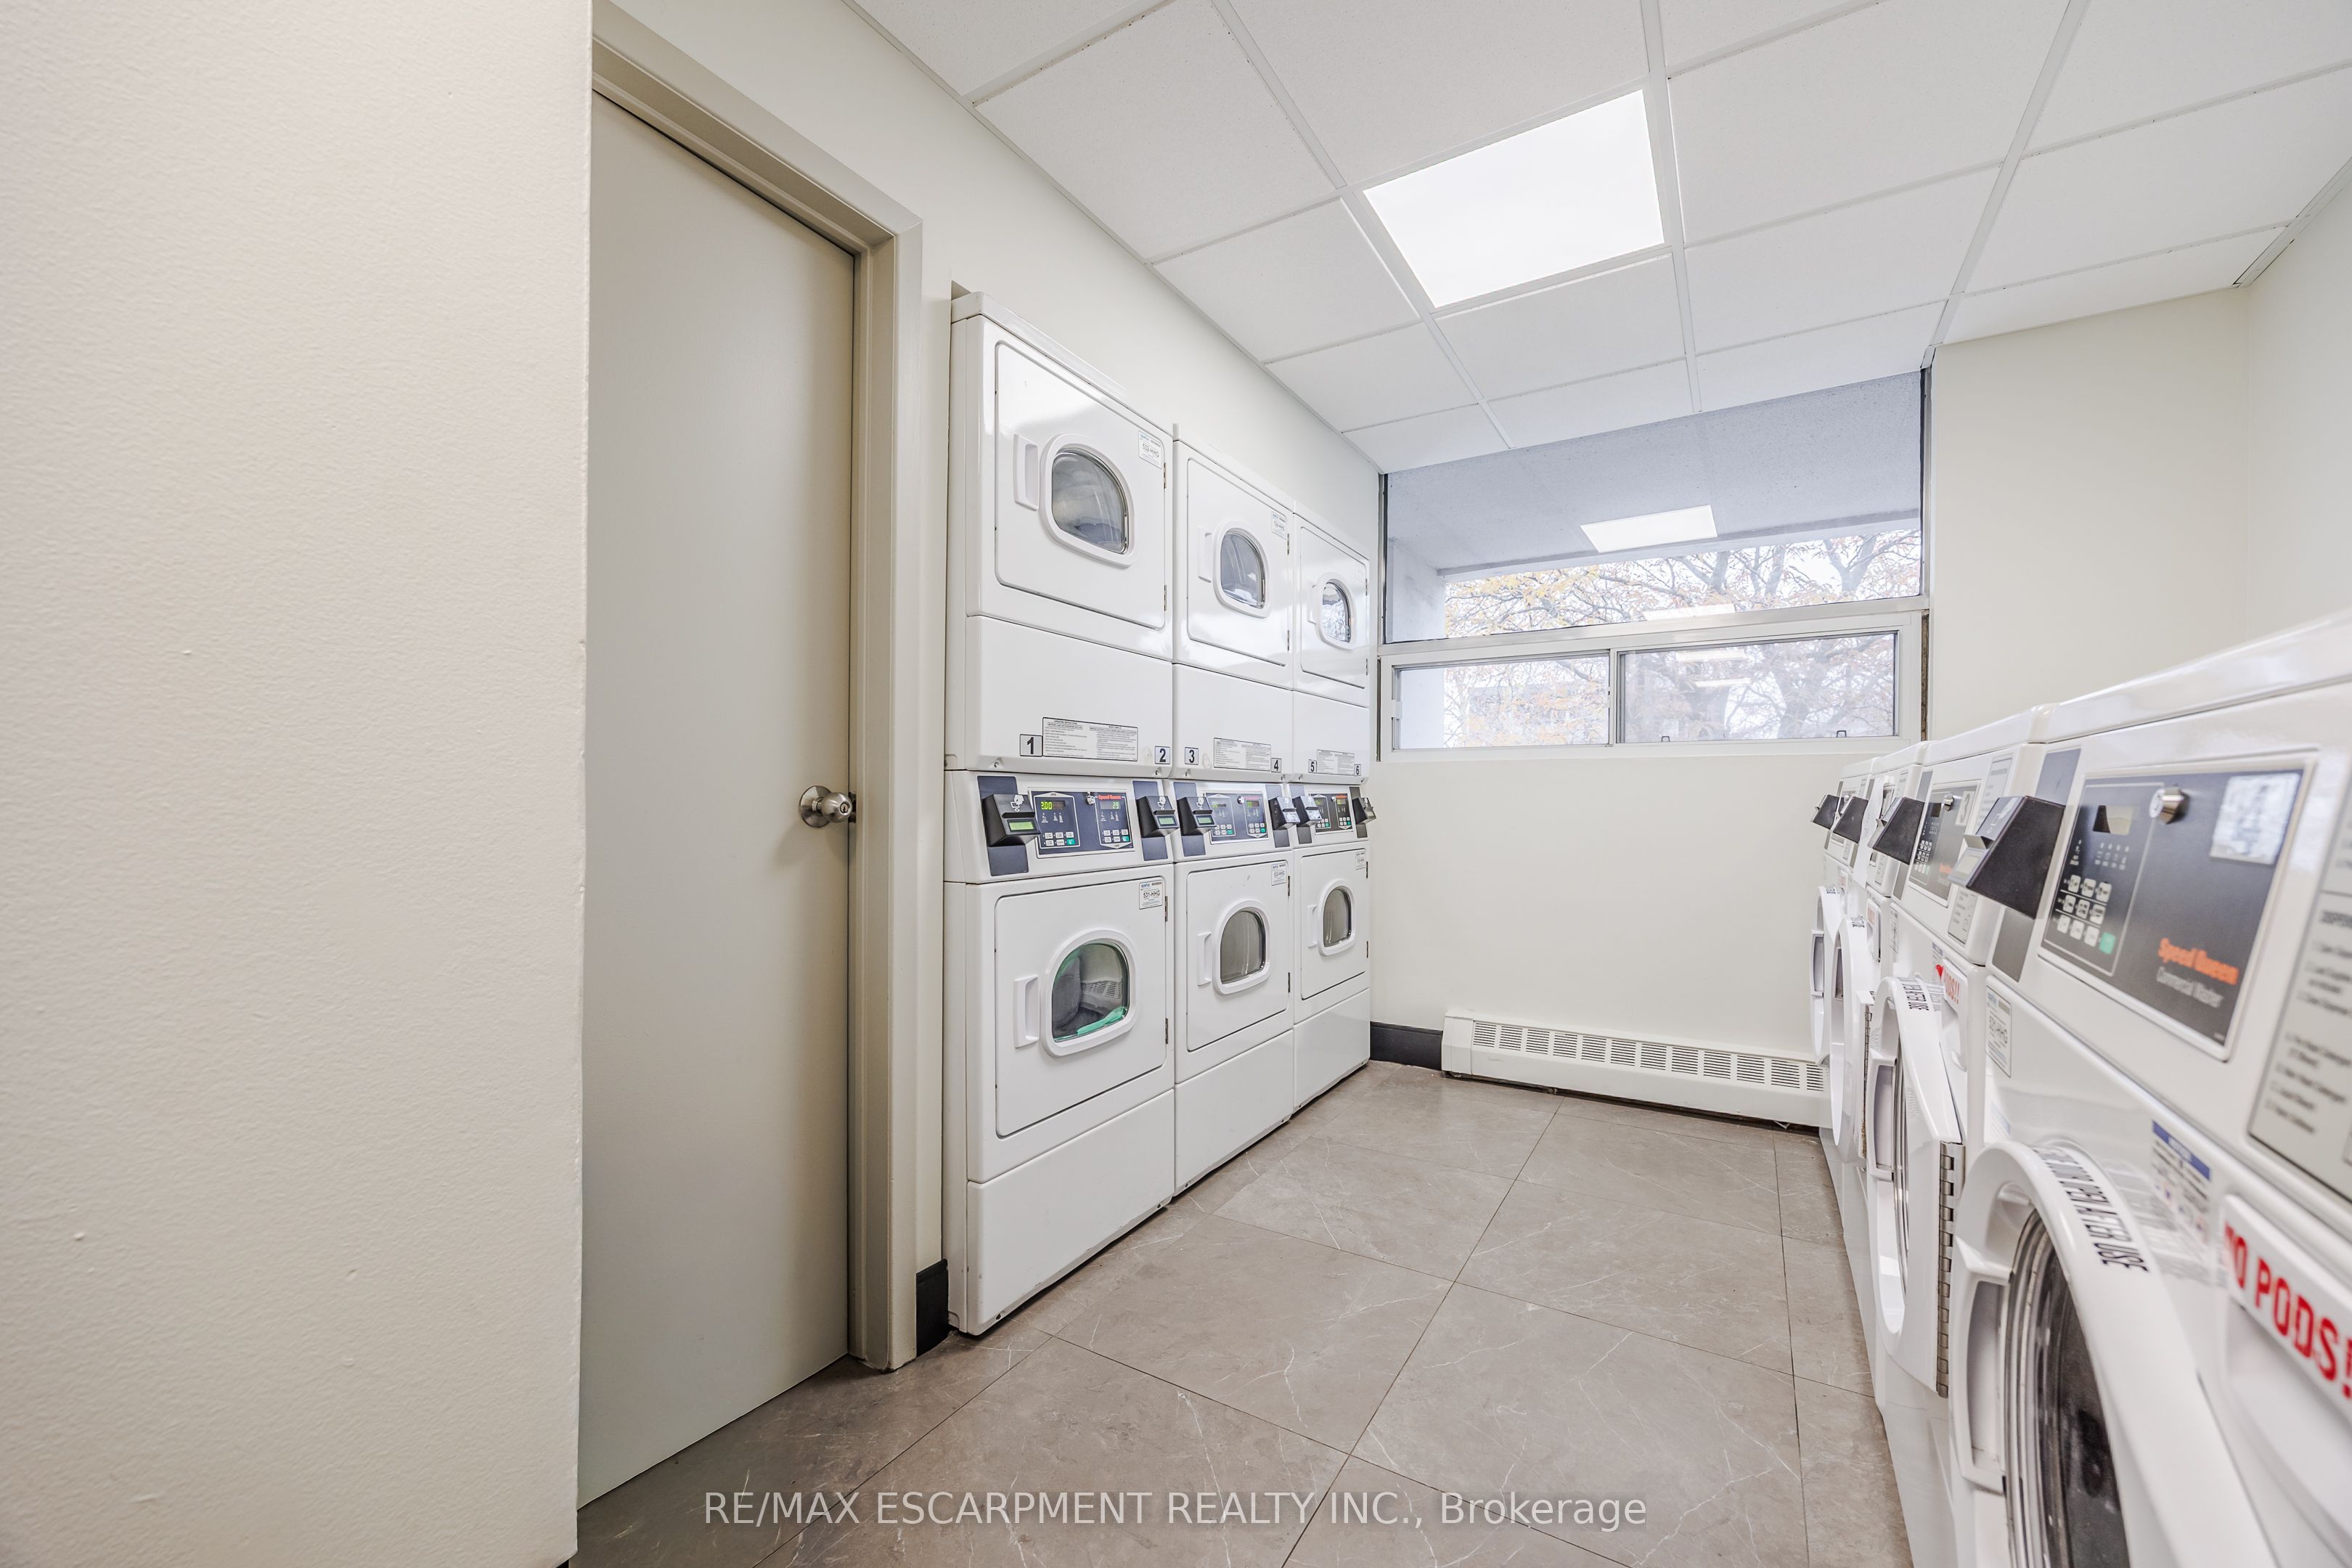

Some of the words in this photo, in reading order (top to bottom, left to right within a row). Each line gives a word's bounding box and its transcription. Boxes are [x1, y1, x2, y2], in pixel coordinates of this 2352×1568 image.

[1026, 736, 1034, 755] 1
[1159, 748, 1167, 763] 2
[1189, 749, 1195, 764] 3
[1274, 759, 1279, 772] 4
[1311, 761, 1315, 772] 5
[1356, 765, 1360, 775] 6
[2094, 1242, 2150, 1273] USE
